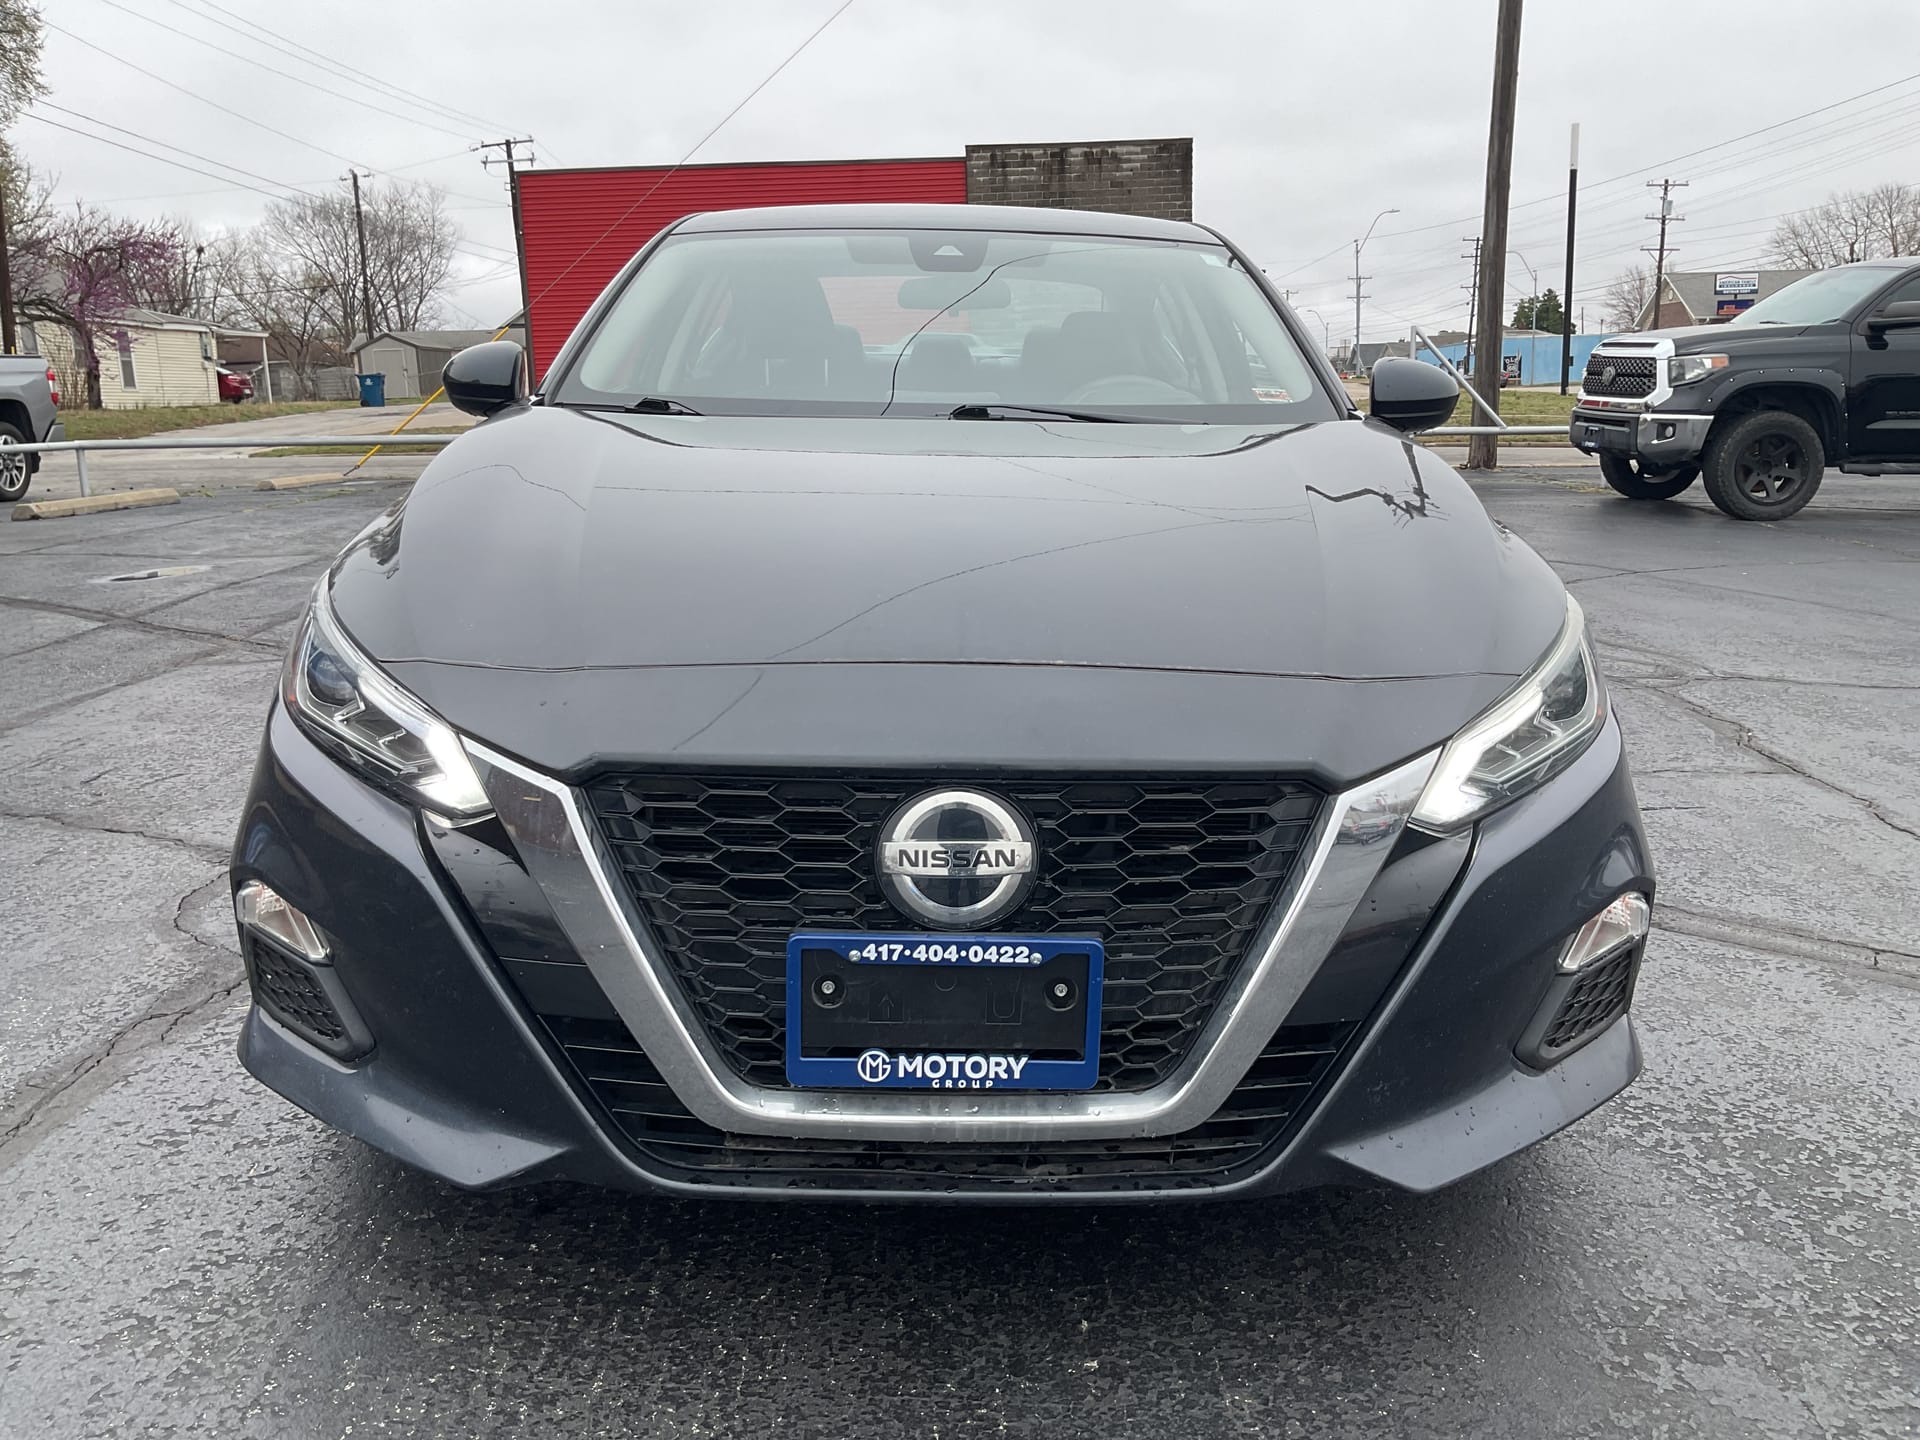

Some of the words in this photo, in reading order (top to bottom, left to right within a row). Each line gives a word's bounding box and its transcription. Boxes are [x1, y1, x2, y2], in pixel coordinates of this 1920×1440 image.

[898, 848, 1016, 868] NISSAN
[898, 1055, 1028, 1079] MOTORY
[931, 1079, 994, 1089] GROUP
